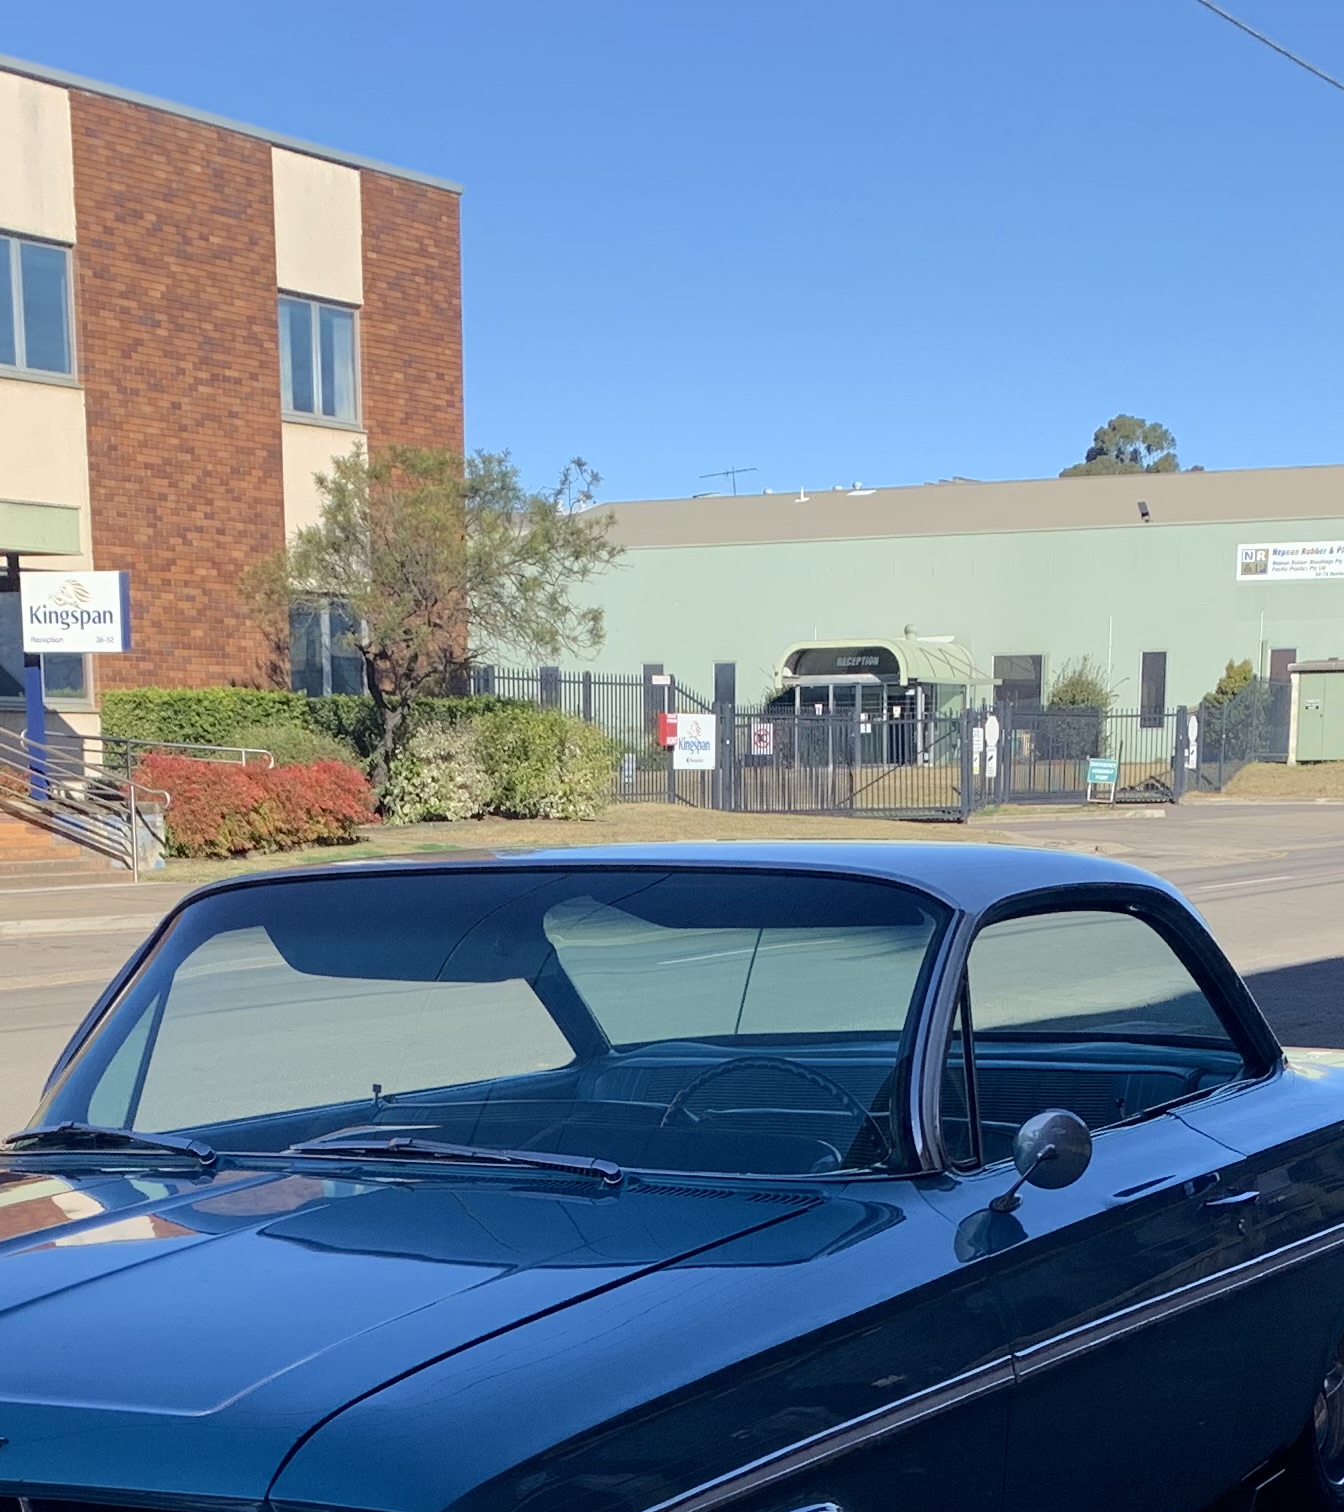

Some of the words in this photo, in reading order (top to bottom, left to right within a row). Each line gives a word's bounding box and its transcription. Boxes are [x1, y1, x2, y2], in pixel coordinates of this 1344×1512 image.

[1244, 551, 1254, 561] N
[1256, 550, 1266, 561] R
[1272, 548, 1299, 557] Nepean
[1301, 547, 1327, 556] Rubber
[1328, 546, 1334, 555] &
[29, 603, 114, 631] Kingspan
[30, 636, 64, 644] Reception
[837, 655, 880, 667] RECEPTION
[678, 737, 711, 755] Kingspan
